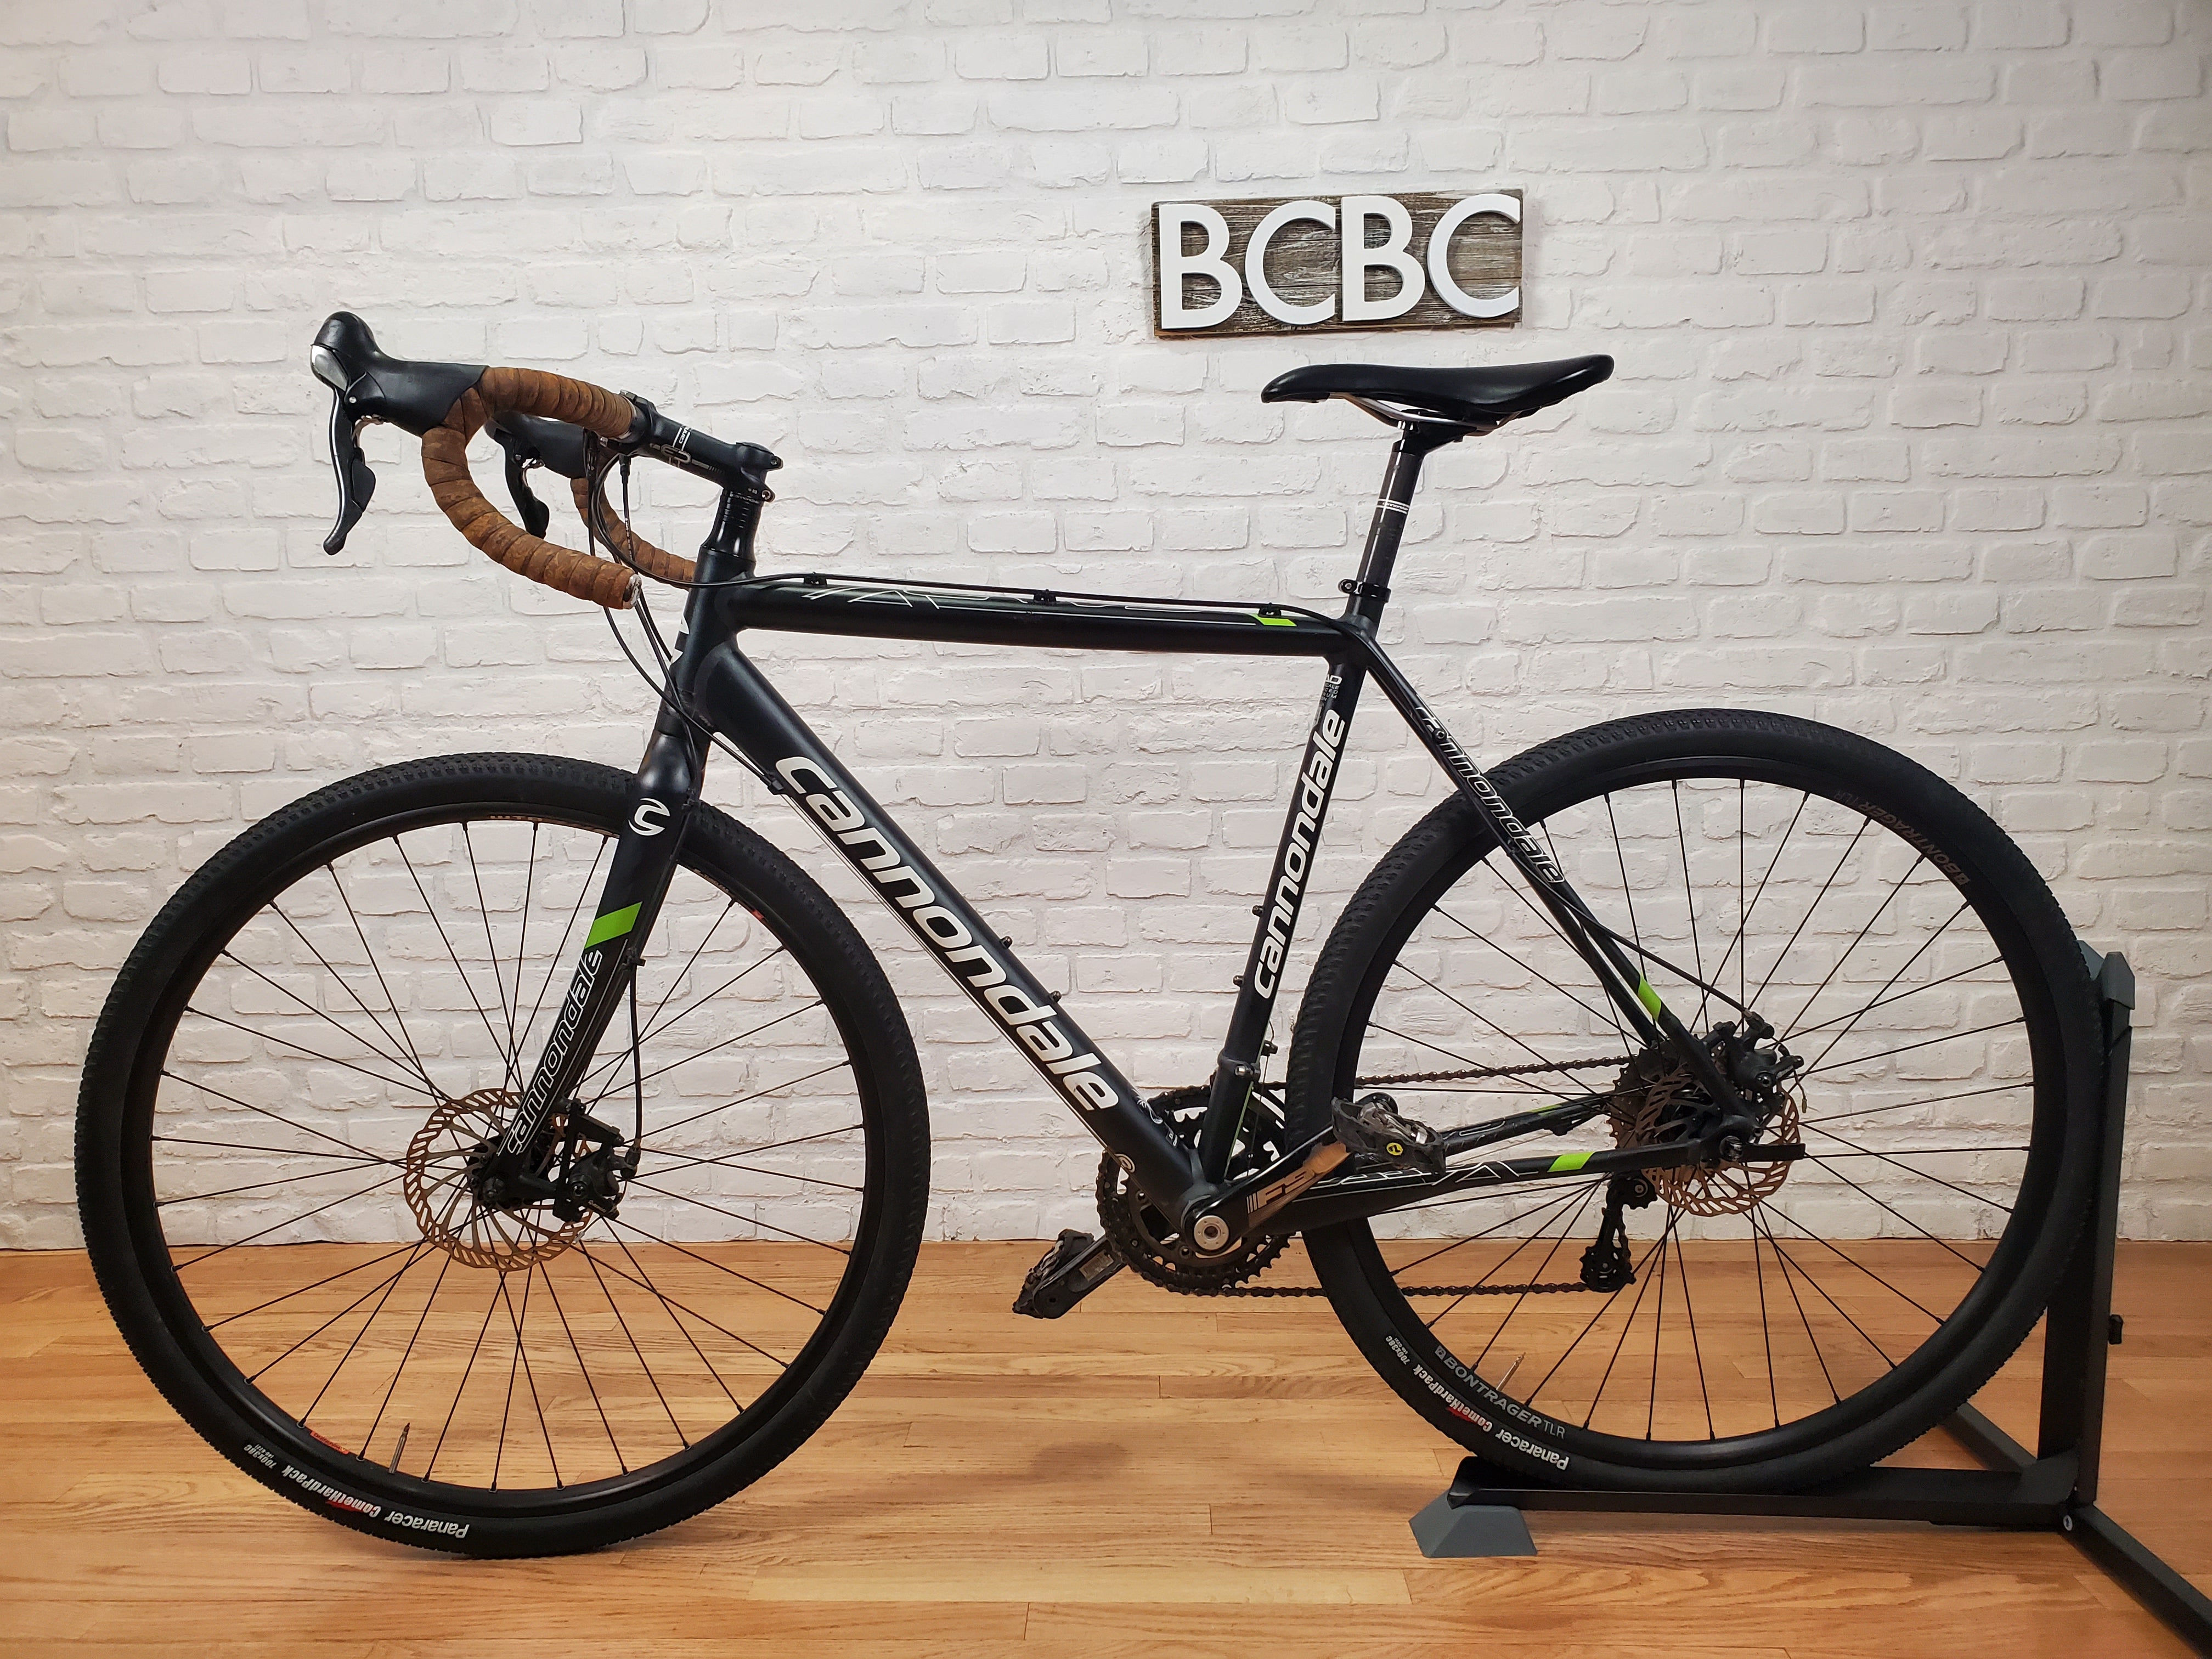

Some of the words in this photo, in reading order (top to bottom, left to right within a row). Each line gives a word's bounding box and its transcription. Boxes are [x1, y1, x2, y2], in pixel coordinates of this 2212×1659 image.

[1159, 193, 1520, 329] BCBC
[1254, 709, 1345, 999] cannondale
[1858, 802, 1962, 874] BONTRAGER
[776, 756, 1119, 1111] cannondale
[508, 949, 603, 1154] cannondale
[1443, 1357, 1542, 1429] BONTRAGER
[1543, 1421, 1566, 1440] TLR
[1494, 1429, 1570, 1471] Panaracer
[384, 1511, 470, 1539] Panaracer
